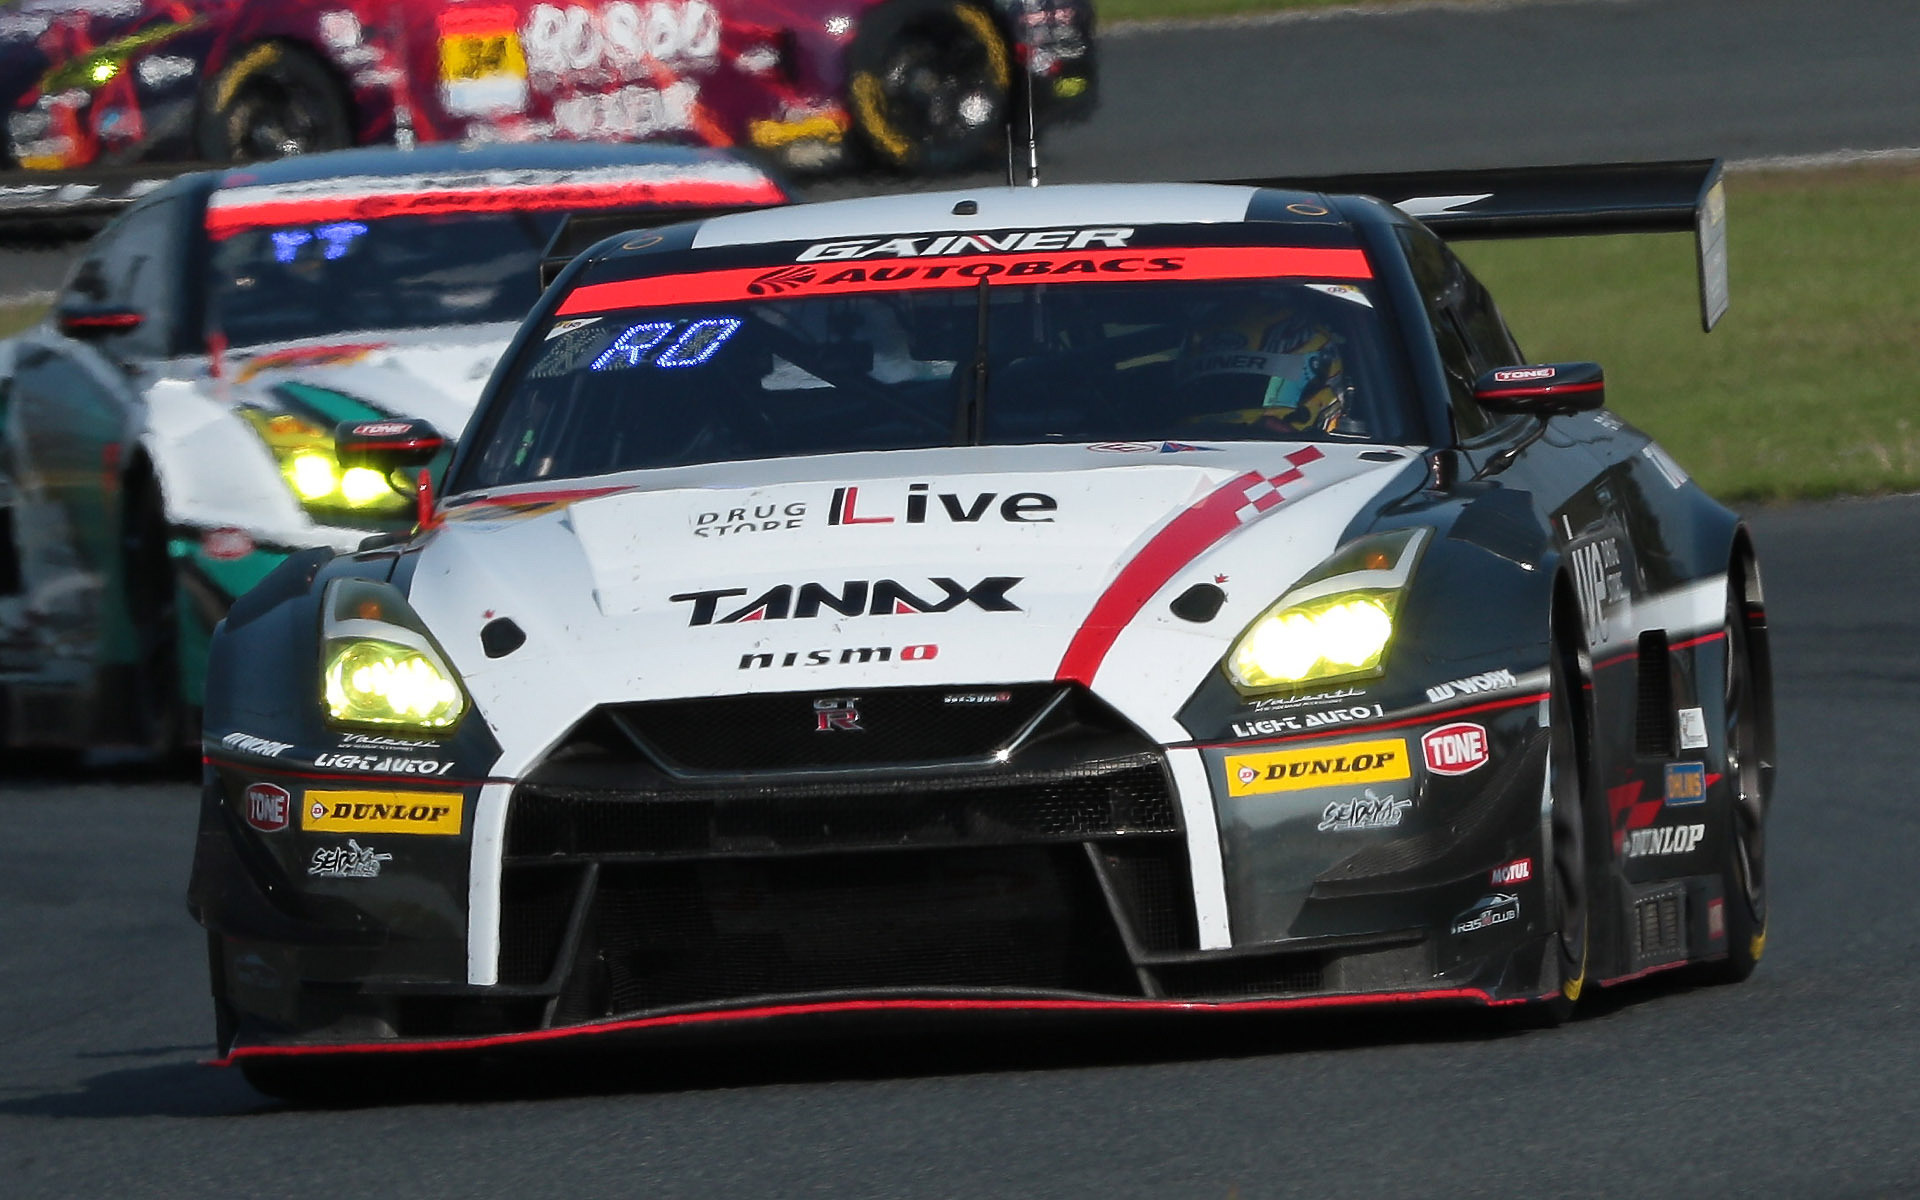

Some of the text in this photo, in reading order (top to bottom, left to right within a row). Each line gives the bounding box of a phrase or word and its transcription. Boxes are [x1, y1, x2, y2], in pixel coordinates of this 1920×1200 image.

[796, 228, 1134, 262] GAINER
[818, 256, 1185, 285] AUTOBACS
[1500, 369, 1551, 379] TONE
[696, 502, 807, 525] DRUG
[668, 576, 1025, 627] TANAX
[738, 643, 939, 670] nismo
[1305, 706, 1371, 728] AUTO
[1428, 731, 1483, 766] TONE
[373, 757, 442, 775] AUTO
[1264, 752, 1395, 781] DUNLOP
[250, 792, 285, 824] TONE
[330, 803, 450, 822] DUNLOP
[1491, 862, 1530, 884] MOTUL
